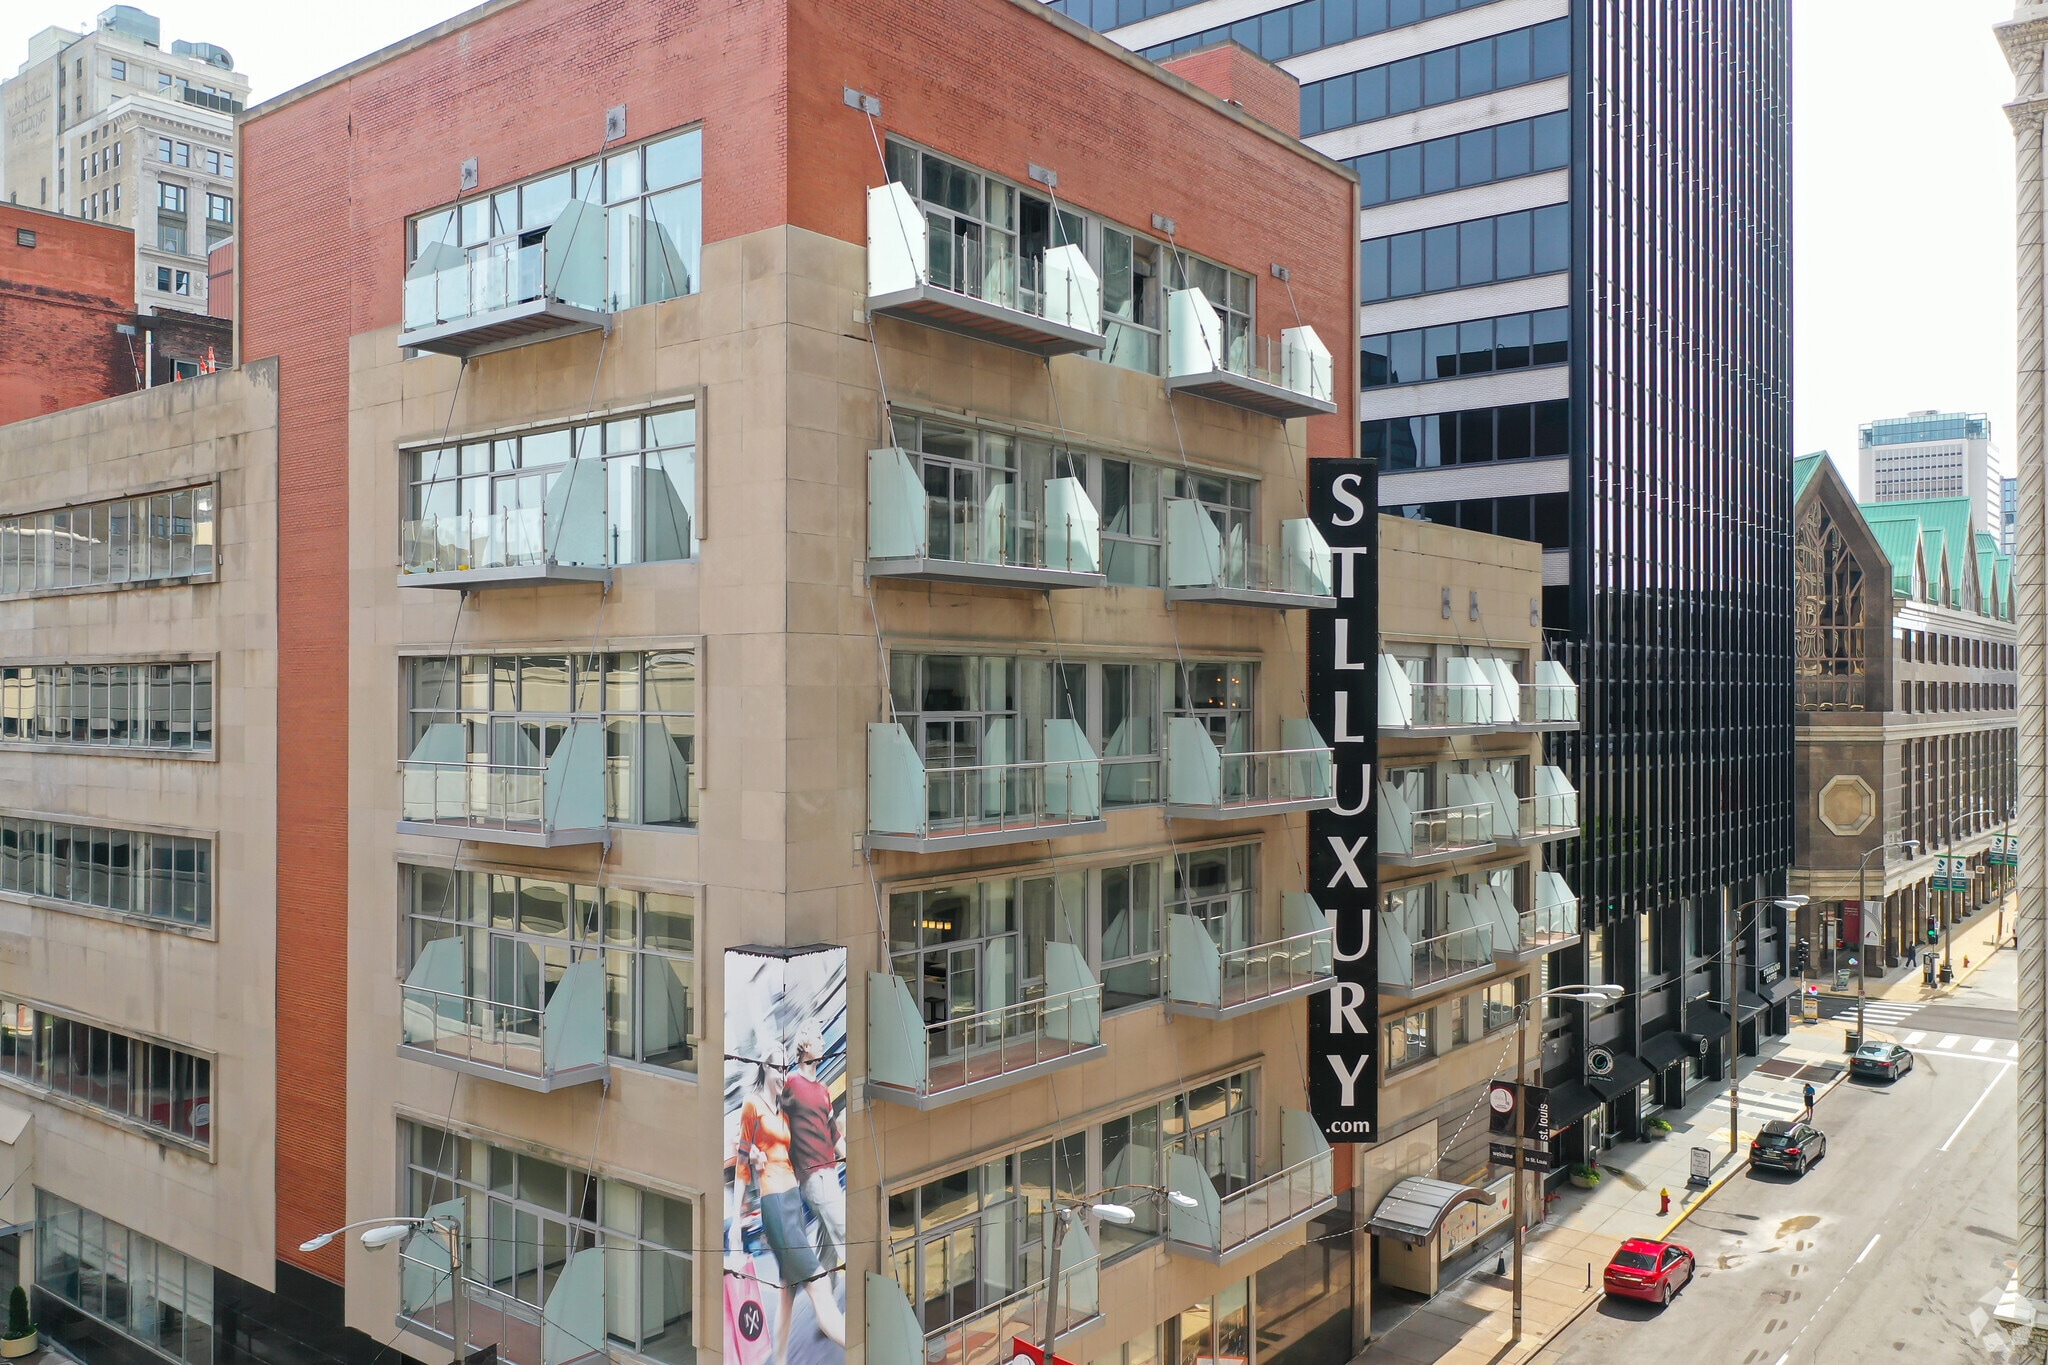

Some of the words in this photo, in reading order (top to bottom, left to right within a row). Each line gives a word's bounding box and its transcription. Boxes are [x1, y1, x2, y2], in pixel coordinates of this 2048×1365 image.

[1538, 1103, 1548, 1127] louis
[1325, 1119, 1370, 1134] .com
[1538, 1129, 1548, 1141] st.
[1492, 1151, 1513, 1159] welcome
